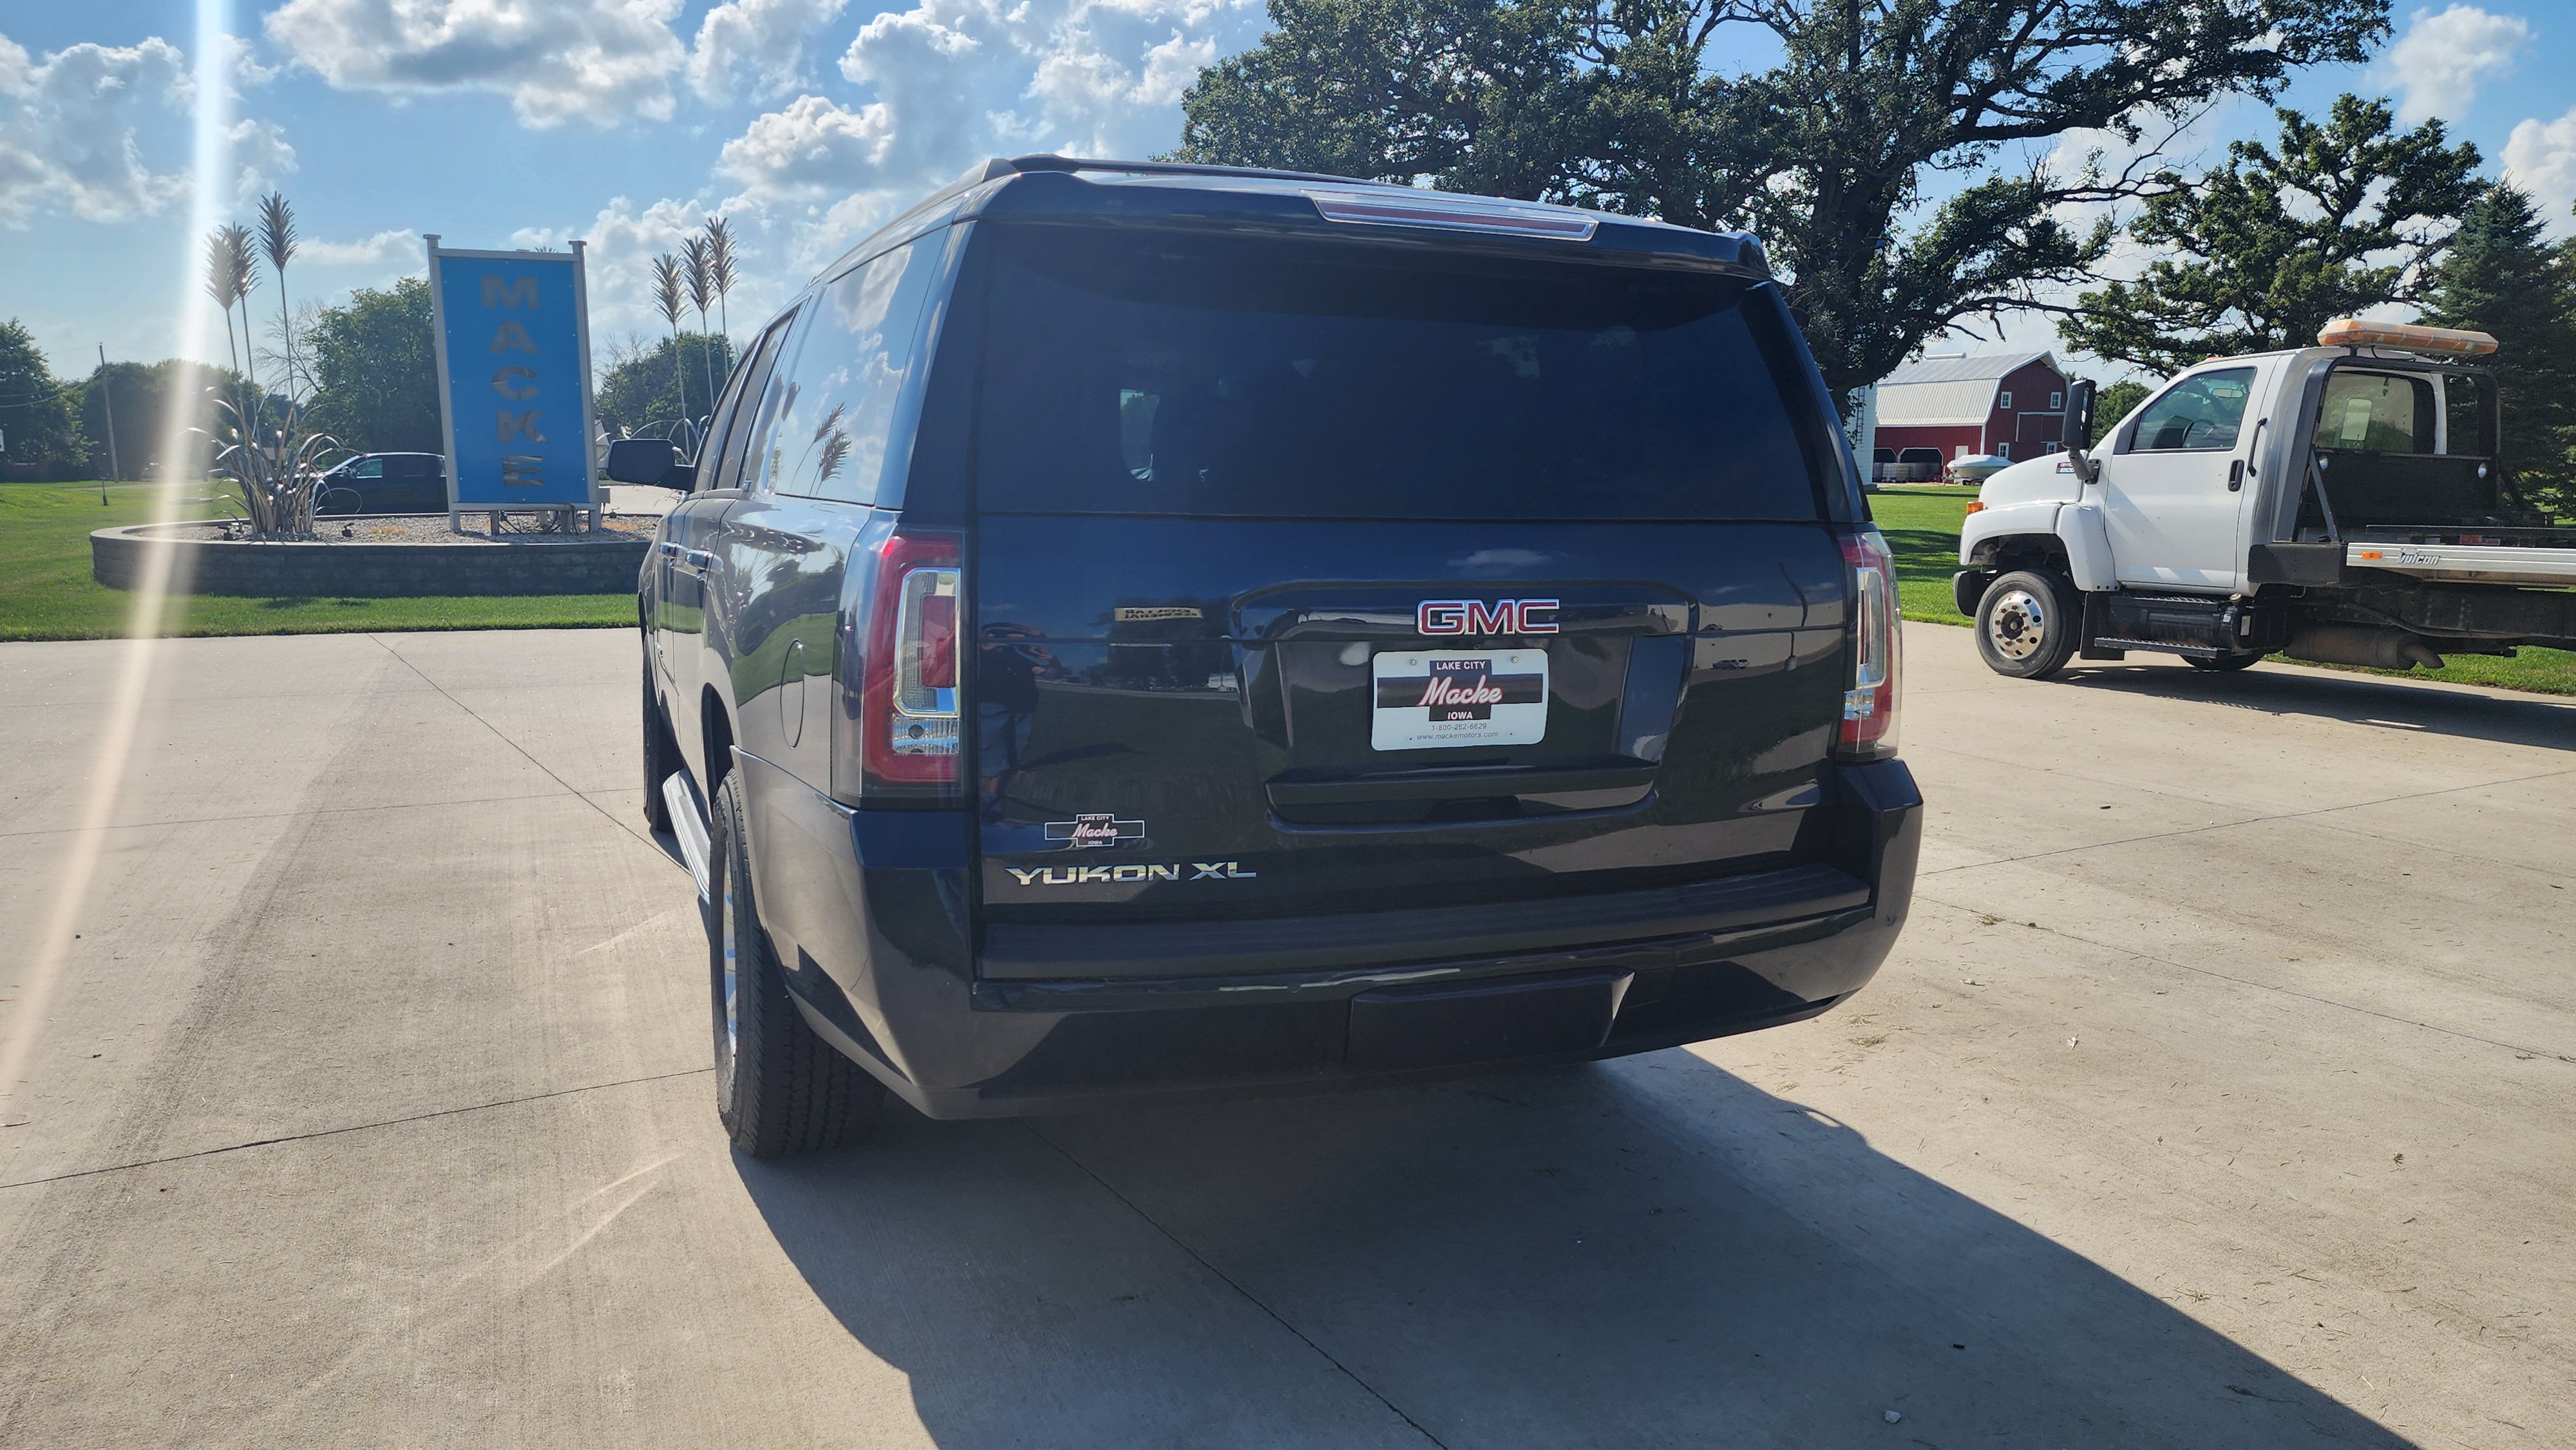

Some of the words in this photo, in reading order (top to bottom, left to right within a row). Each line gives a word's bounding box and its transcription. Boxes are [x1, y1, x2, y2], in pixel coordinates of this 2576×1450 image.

[480, 275, 549, 487] MACKE
[1417, 598, 1560, 636] GMC
[1436, 661, 1461, 670] LAKE
[1463, 661, 1486, 670] CITY
[1416, 674, 1503, 707] Macke
[1447, 711, 1473, 720] IOWA
[1416, 732, 1499, 740] www.mackemotors.com
[1071, 822, 1118, 838] Macke
[1005, 863, 1180, 885] YUKON
[1189, 862, 1257, 881] XL
